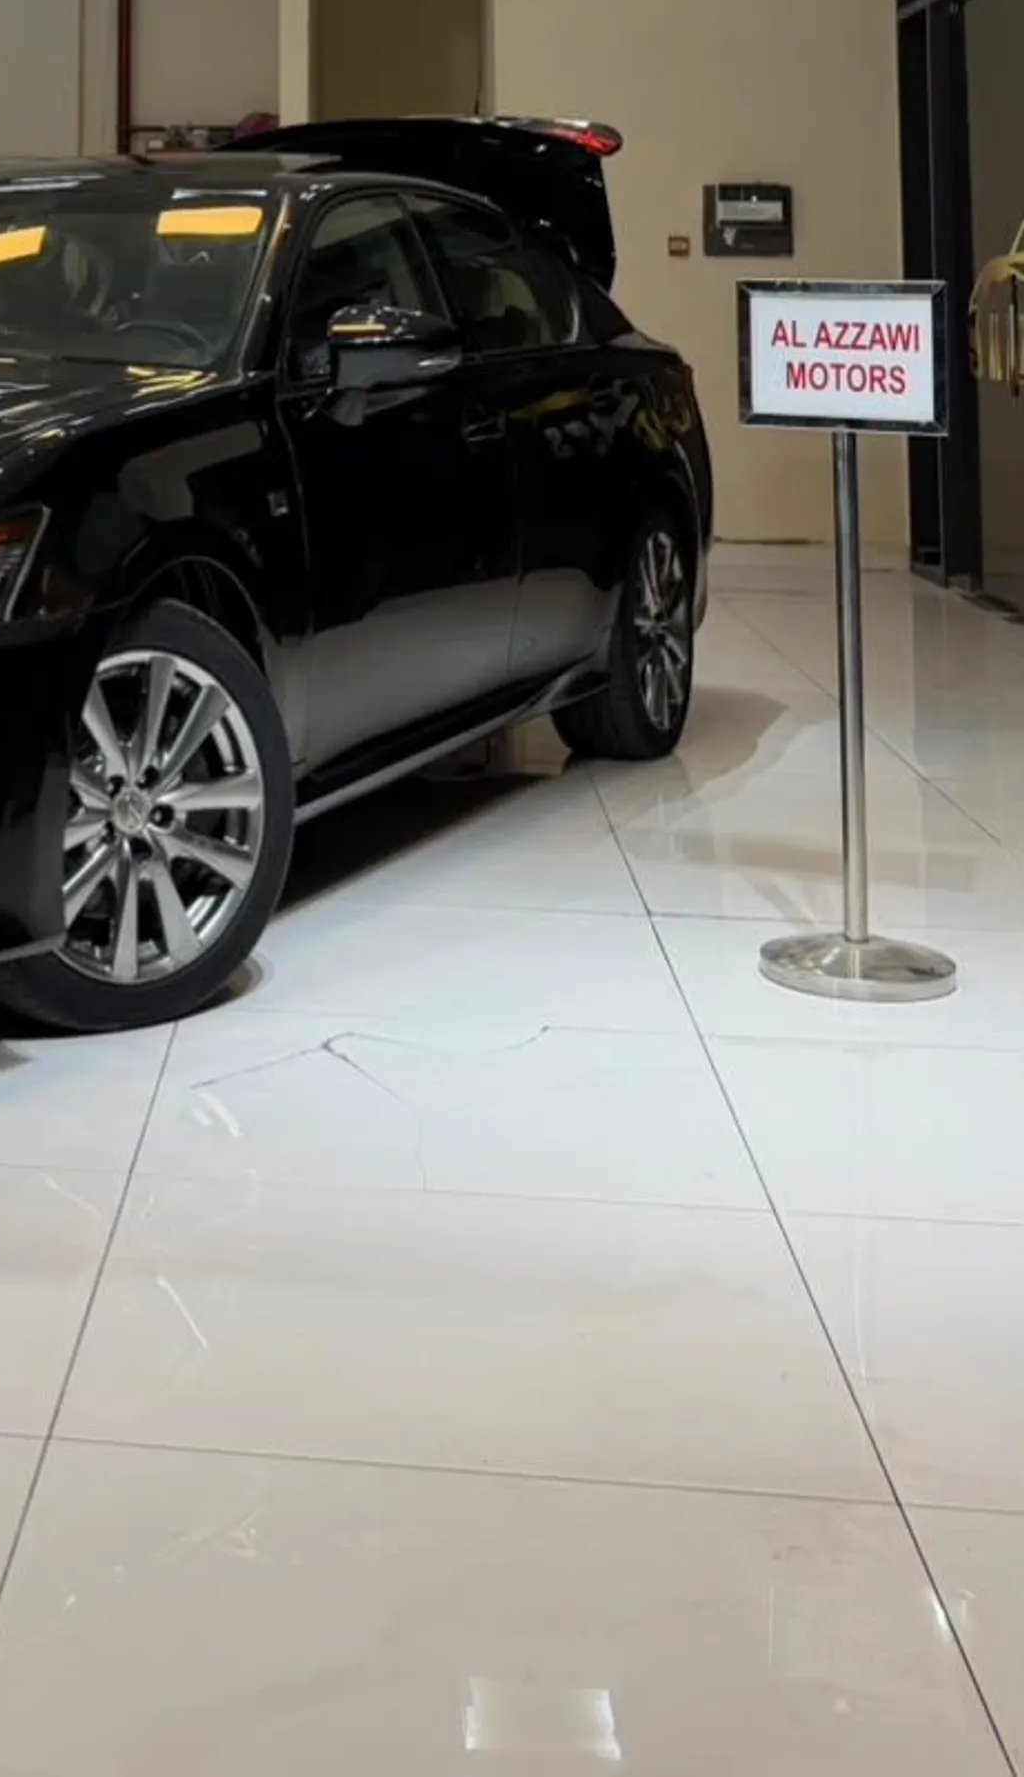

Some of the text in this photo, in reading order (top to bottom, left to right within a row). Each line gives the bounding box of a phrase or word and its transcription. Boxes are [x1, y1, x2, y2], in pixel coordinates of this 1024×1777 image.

[771, 320, 920, 351] AL AZZAWI
[785, 362, 907, 394] MOTORS
